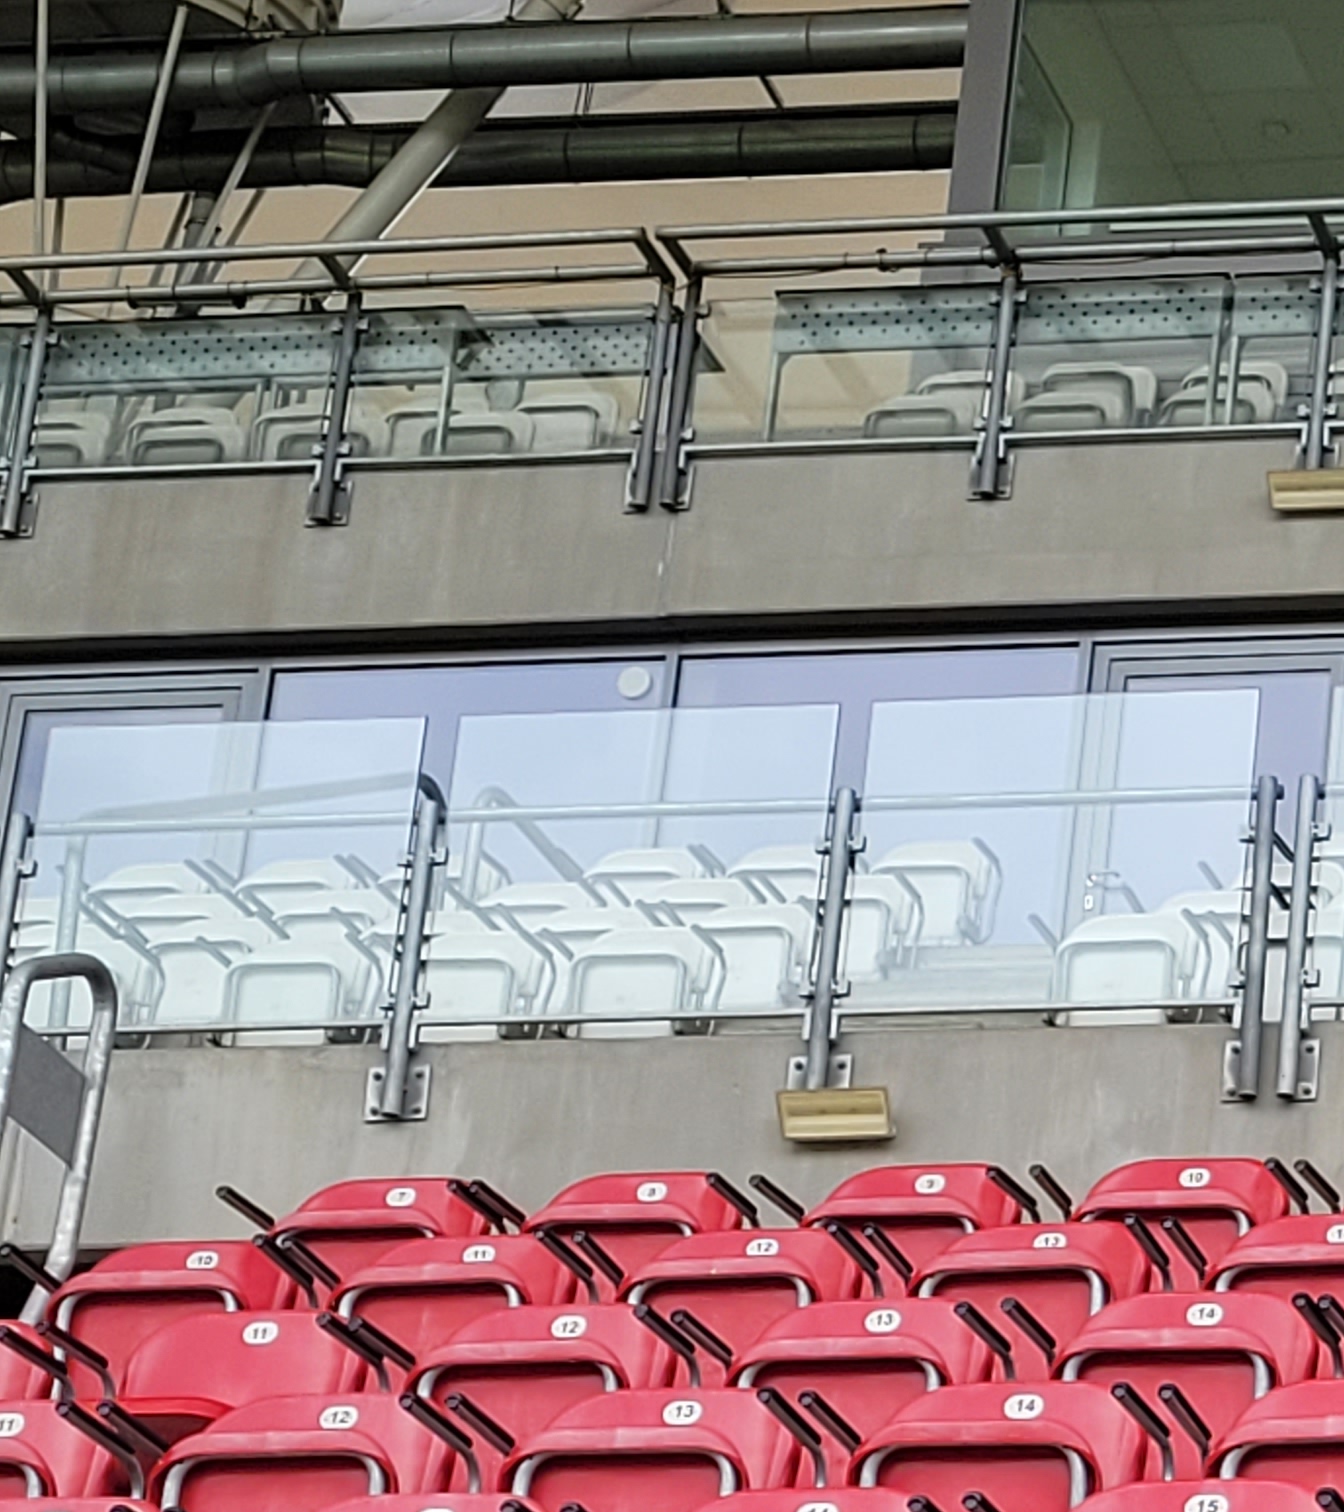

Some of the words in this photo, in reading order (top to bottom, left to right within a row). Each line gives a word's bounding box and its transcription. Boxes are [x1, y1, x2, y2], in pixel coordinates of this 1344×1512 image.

[877, 1313, 893, 1326] 13
[1198, 1307, 1215, 1320] 14
[253, 1327, 268, 1340] 11
[561, 1320, 580, 1334] 12
[675, 1404, 695, 1418] 13
[1017, 1399, 1035, 1413] 14
[330, 1410, 351, 1424] 12
